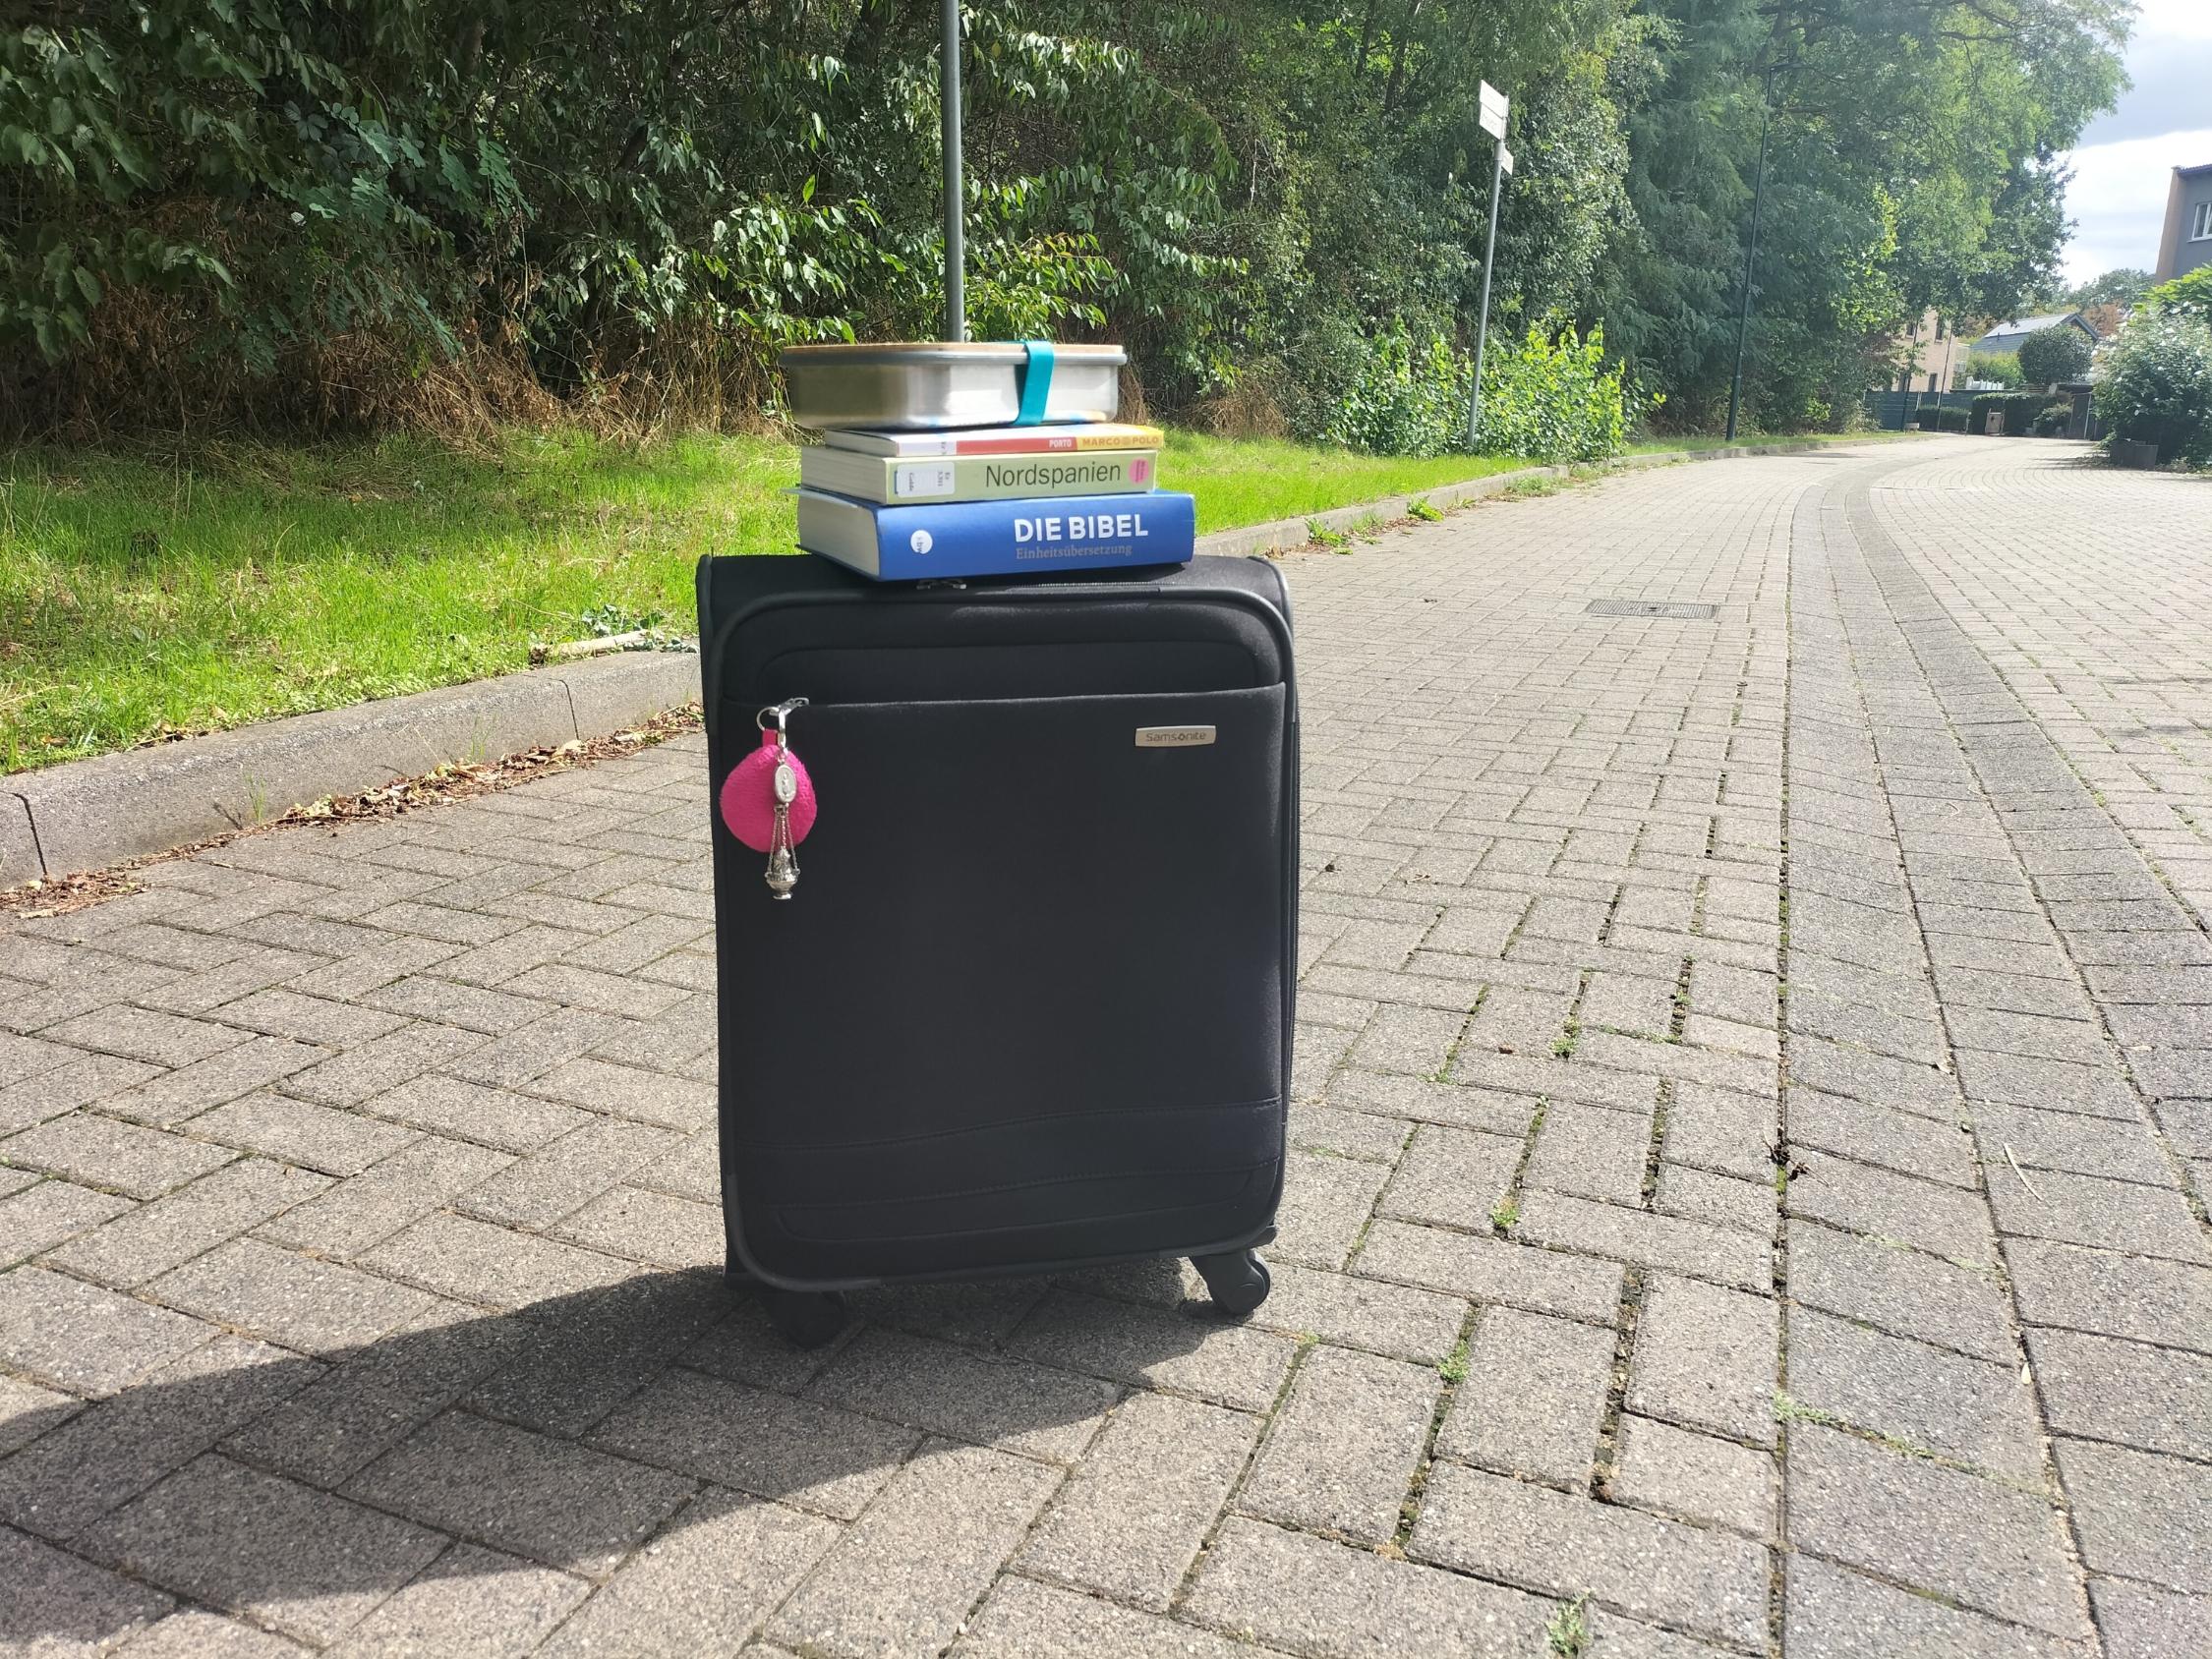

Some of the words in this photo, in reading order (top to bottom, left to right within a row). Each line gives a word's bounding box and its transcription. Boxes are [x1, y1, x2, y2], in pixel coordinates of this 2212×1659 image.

[1049, 438, 1073, 449] PORTO
[1082, 436, 1121, 447] MARCO
[1132, 435, 1159, 445] POLO
[985, 461, 1121, 489] Nordspanien
[1014, 517, 1063, 543] DIE
[1068, 513, 1149, 540] BIBEL
[1016, 543, 1134, 560] Einheitsübersetzung
[1145, 730, 1207, 743] Samsonite
